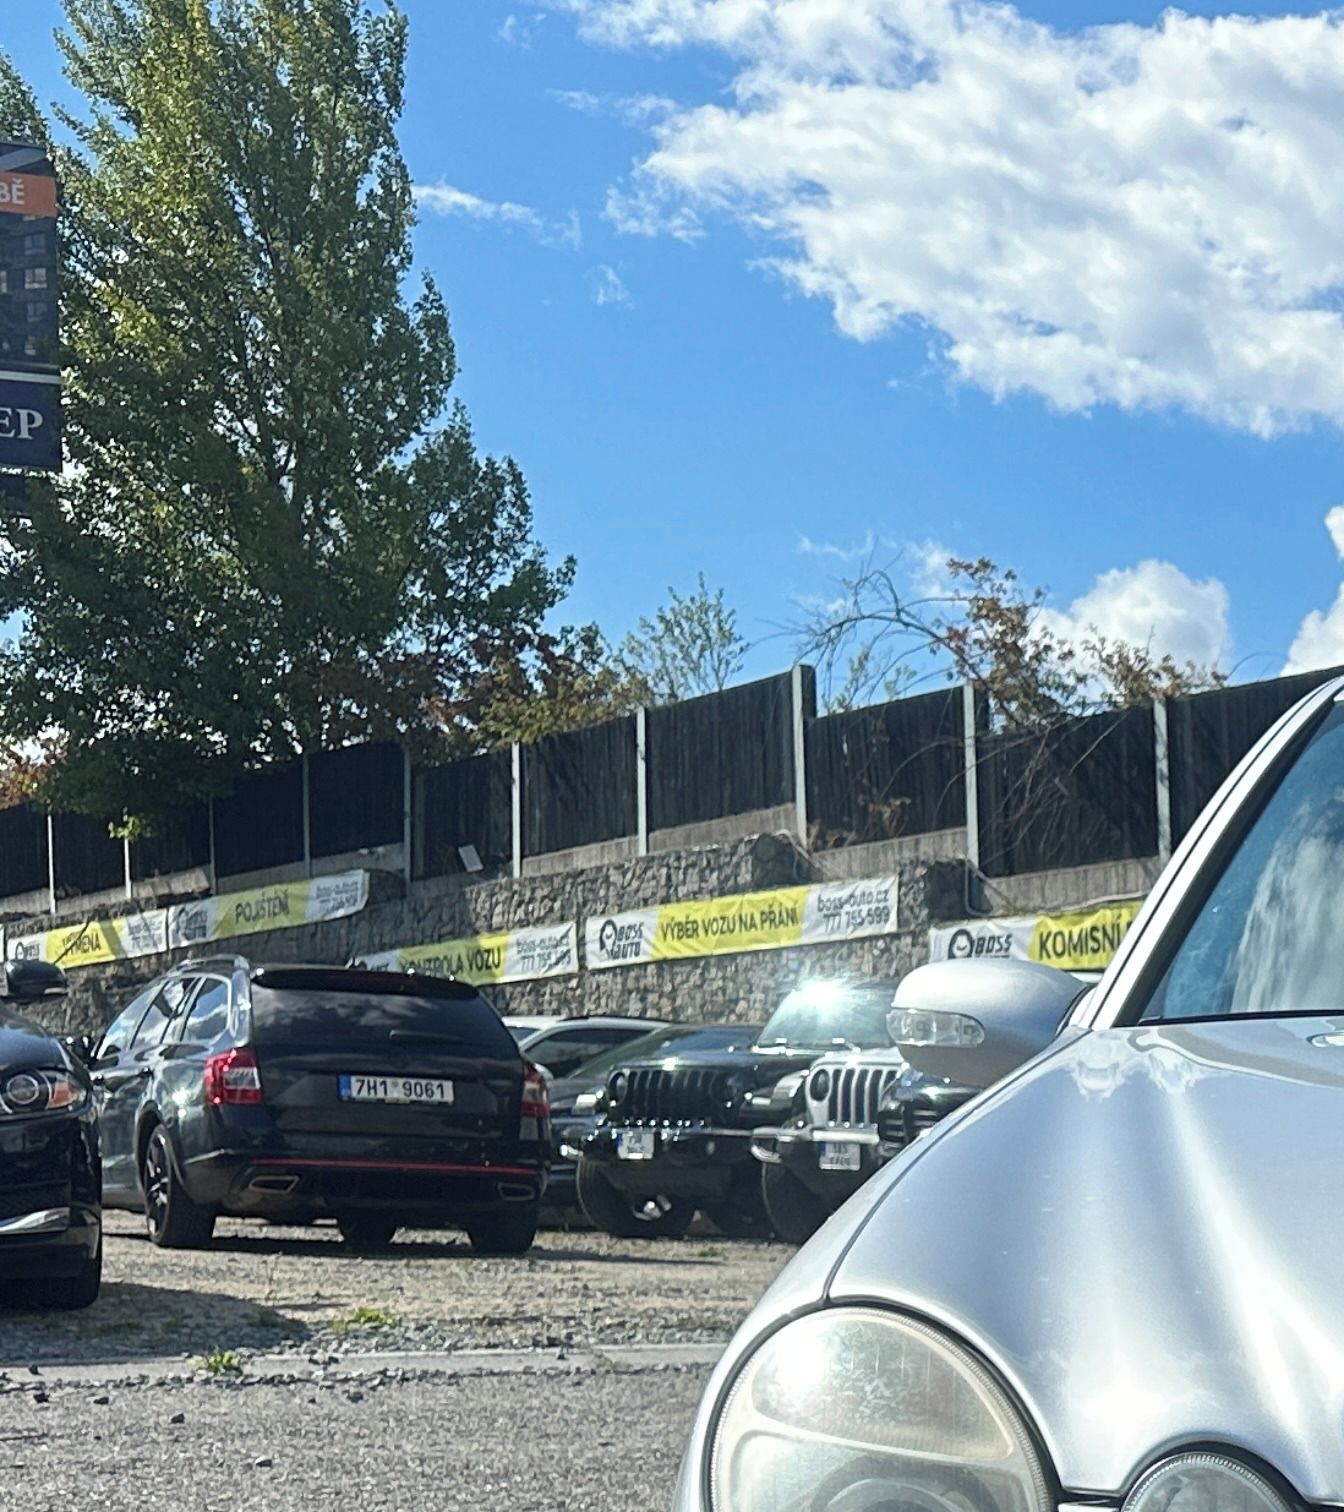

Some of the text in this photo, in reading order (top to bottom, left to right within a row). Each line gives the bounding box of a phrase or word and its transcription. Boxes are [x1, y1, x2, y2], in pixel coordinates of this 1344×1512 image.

[702, 914, 736, 937] VOZU
[739, 912, 757, 933] NA
[760, 902, 799, 931] PŘÁNÍ
[823, 911, 842, 933] 777
[618, 921, 644, 942] BOSS
[1039, 914, 1123, 960] KOMISNÍ
[974, 933, 1013, 955] BOSS
[467, 947, 501, 971] VOZU
[355, 1079, 387, 1097] 7H1
[402, 1080, 445, 1099] 9061
